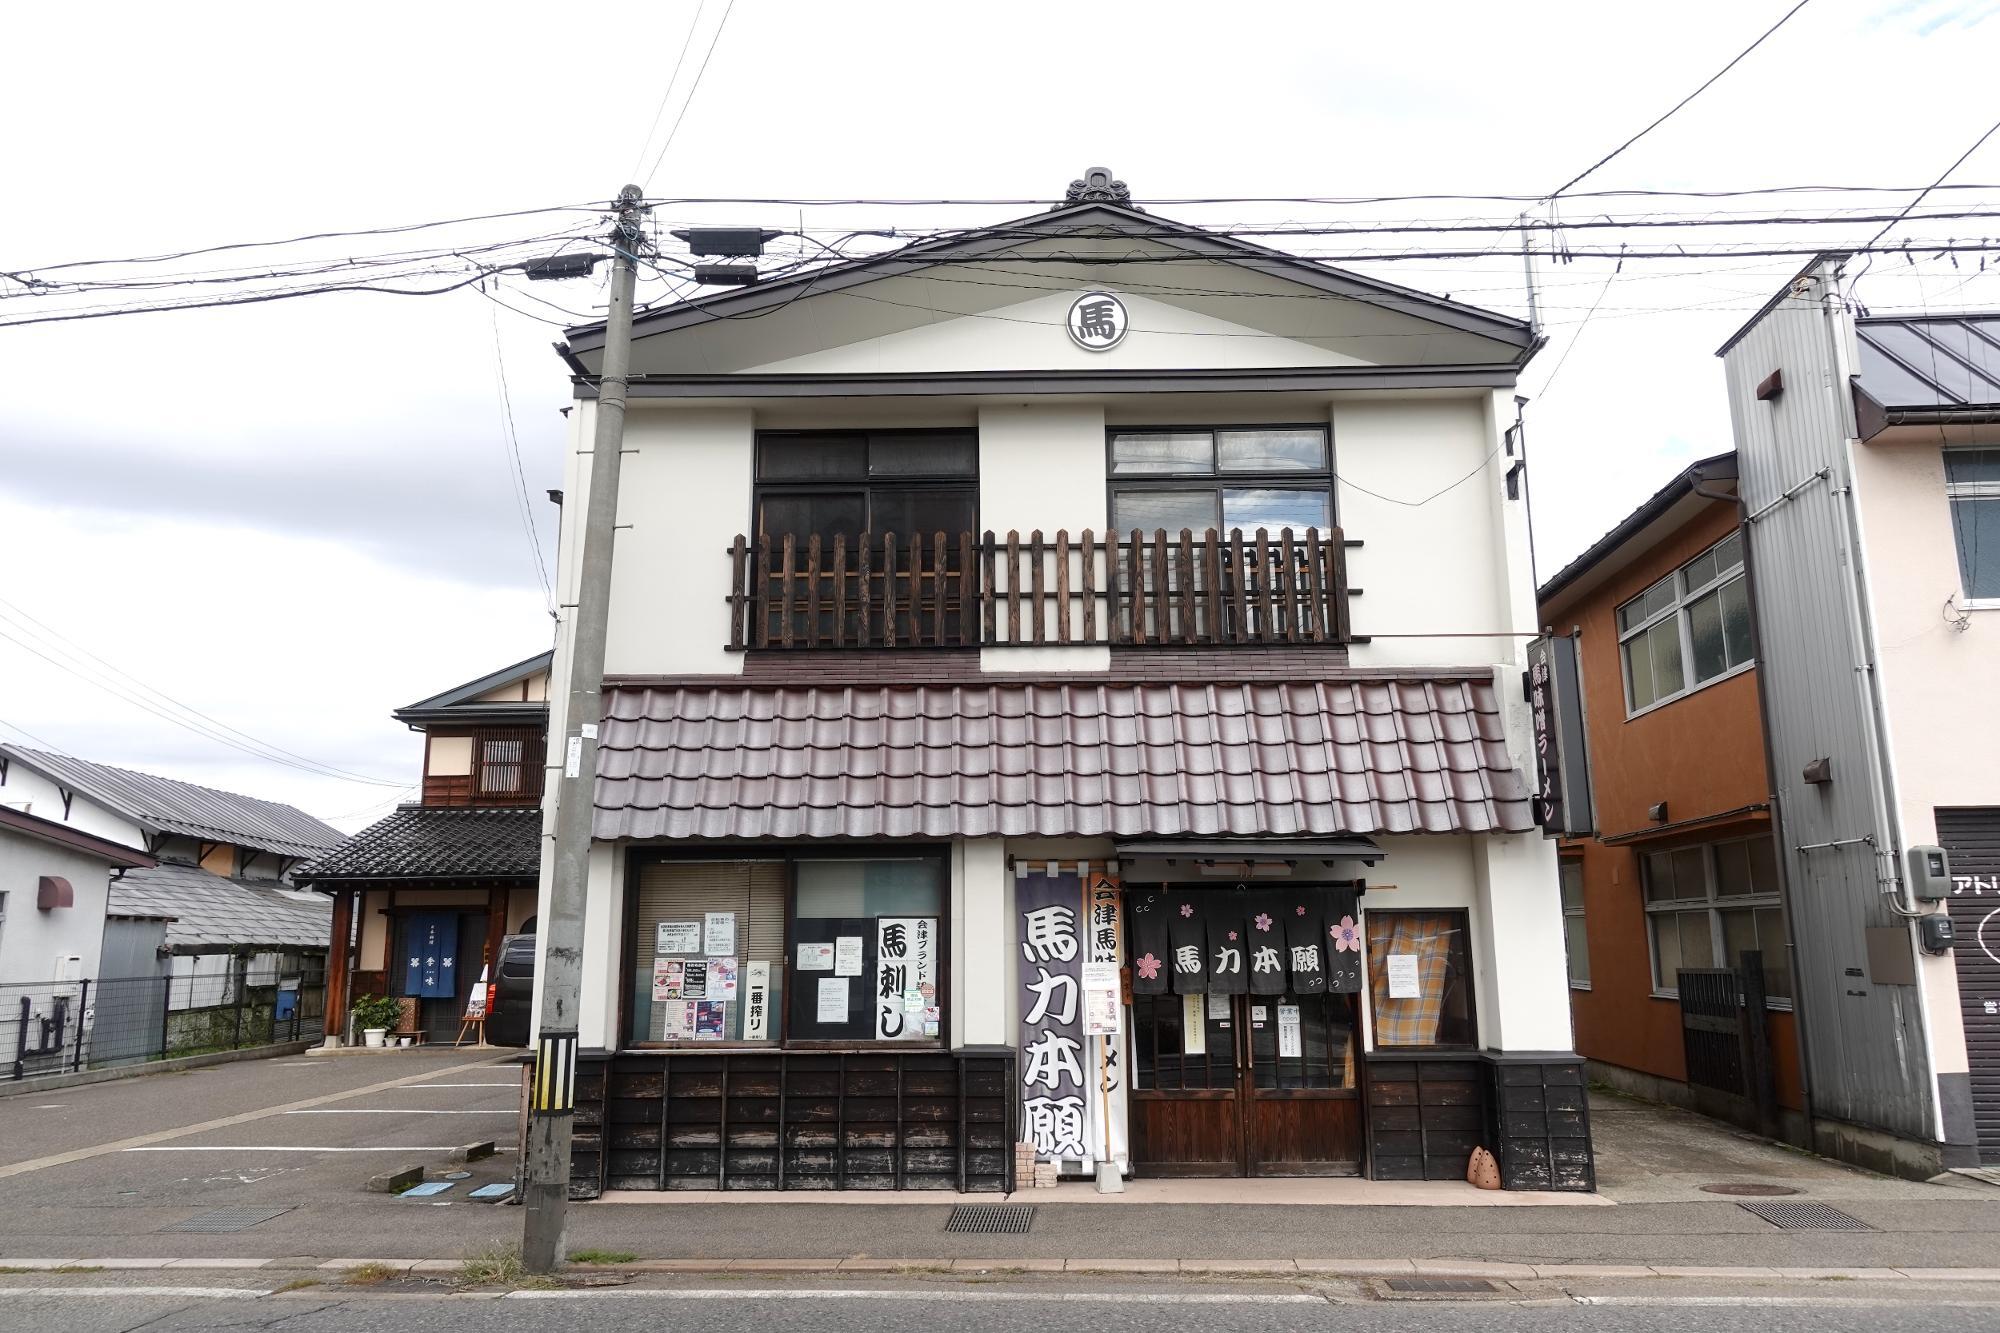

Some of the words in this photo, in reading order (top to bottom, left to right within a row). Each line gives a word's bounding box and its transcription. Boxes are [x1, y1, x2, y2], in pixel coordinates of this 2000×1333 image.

[1078, 300, 1116, 340] 馬
[1540, 648, 1548, 682] 会津
[1175, 944, 1321, 974] 馬力本願
[880, 923, 907, 1038] 馬刺し
[750, 985, 764, 1031] 一番搾り
[1983, 1000, 2000, 1014] 営
[1022, 904, 1085, 1156] 馬力本願
